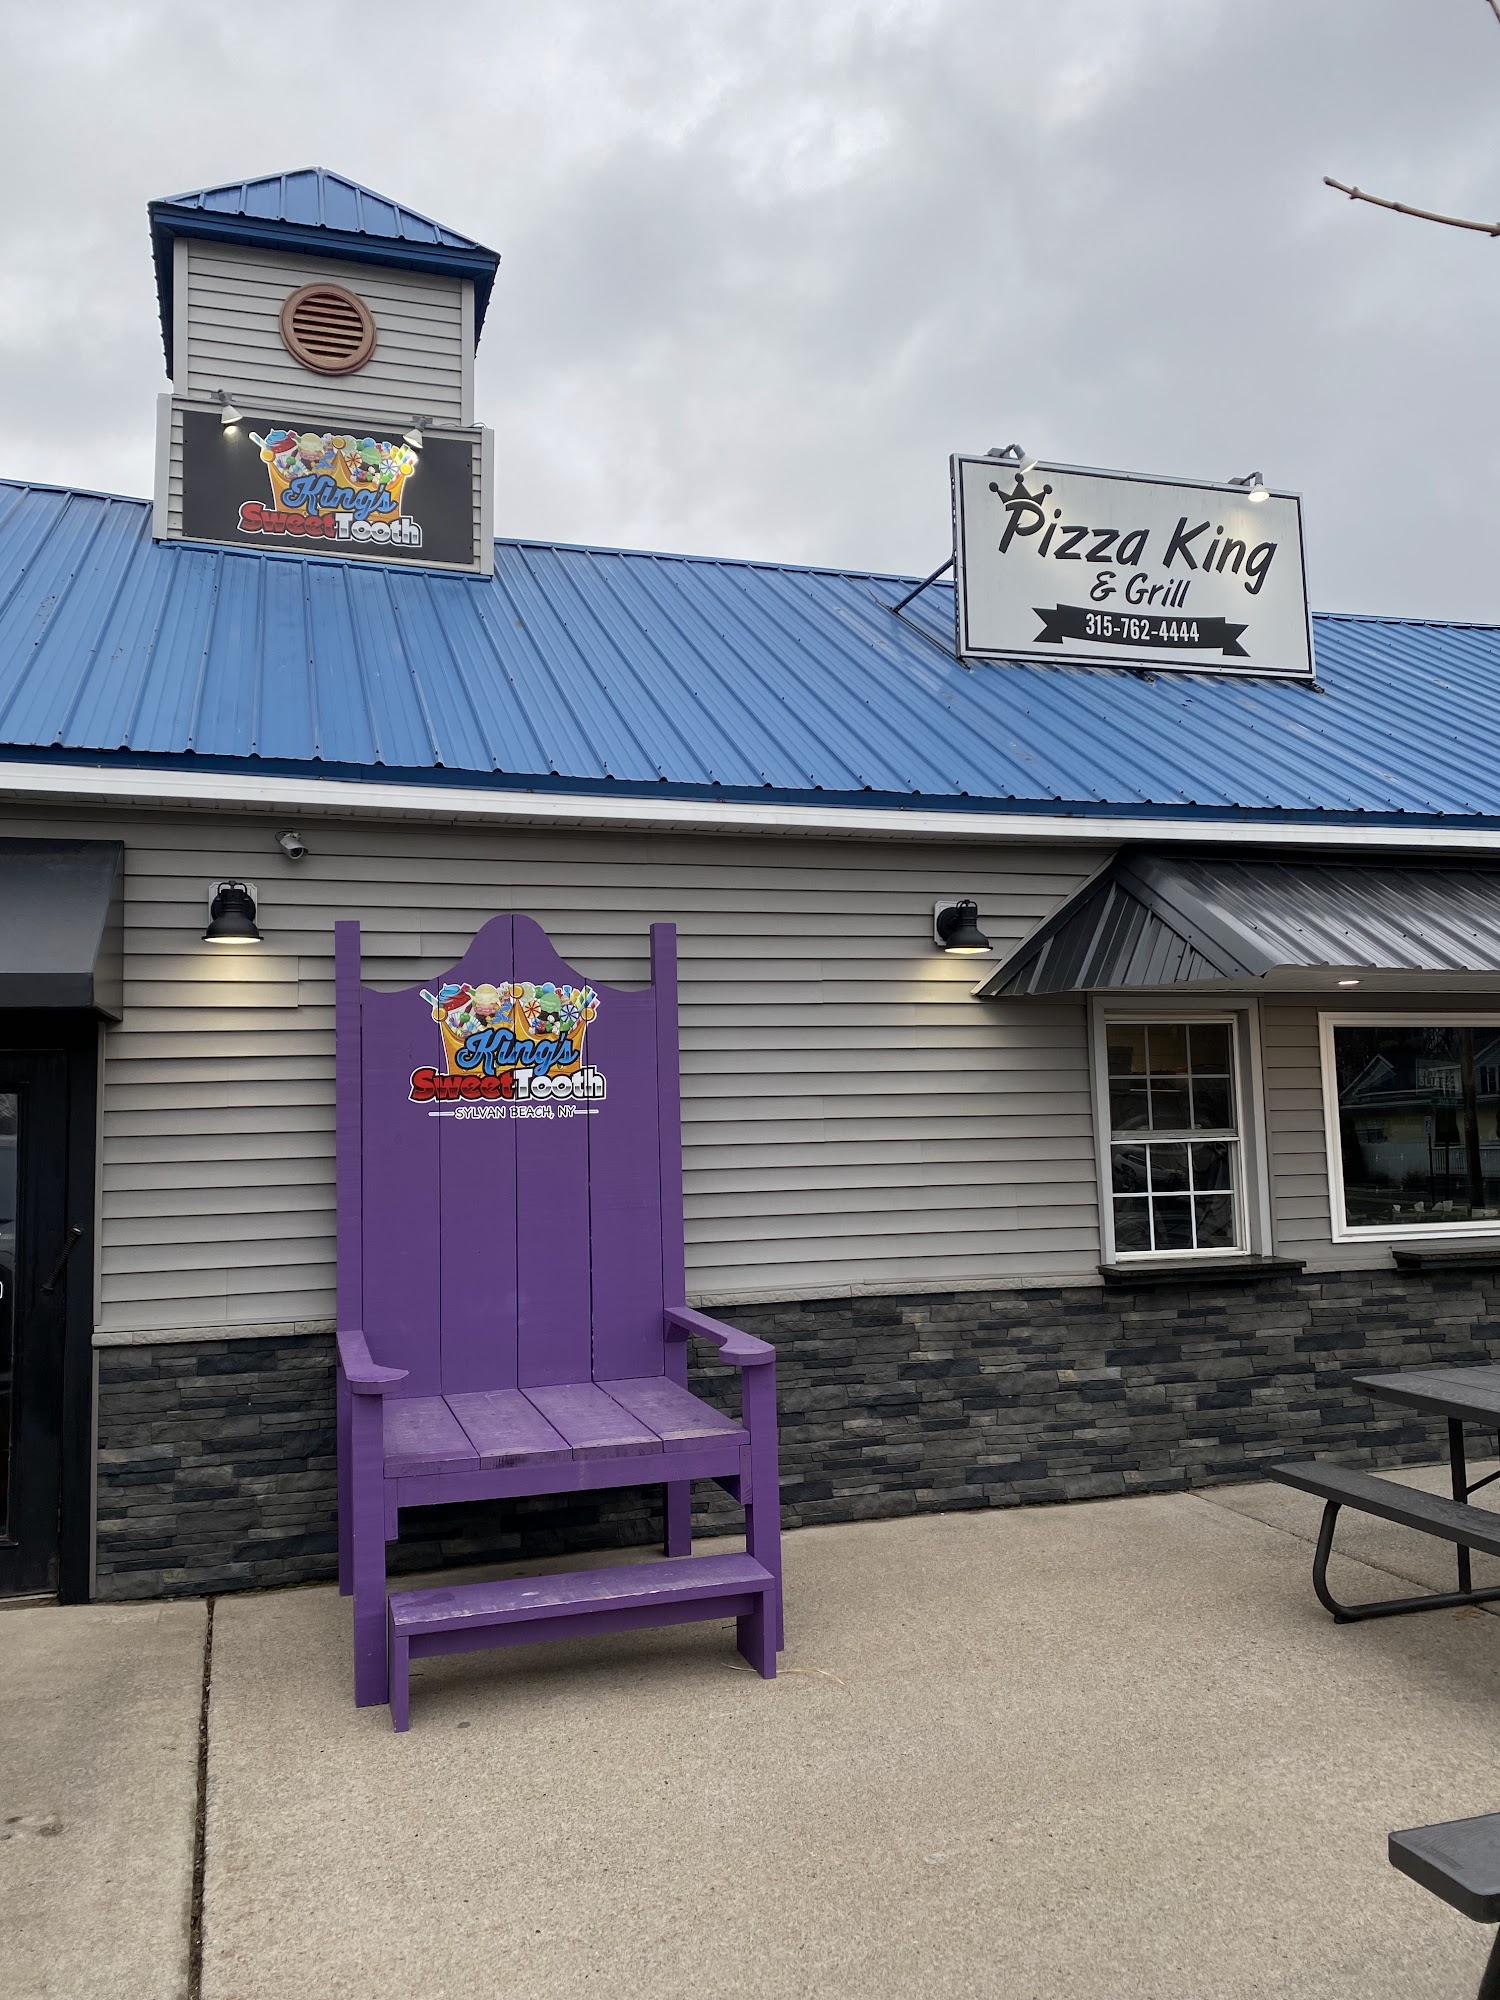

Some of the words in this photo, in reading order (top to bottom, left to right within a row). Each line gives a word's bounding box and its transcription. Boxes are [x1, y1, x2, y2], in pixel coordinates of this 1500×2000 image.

[283, 475, 397, 521] King's
[240, 503, 335, 538] Sweet
[335, 513, 421, 546] Tooth
[998, 500, 1150, 566] Pizza
[1162, 517, 1278, 595] King
[1090, 570, 1117, 602] &
[1125, 572, 1191, 608] Grill
[1085, 613, 1200, 642] 315-762-4444
[456, 1027, 580, 1076] King's
[411, 1067, 514, 1100] Sweet
[515, 1067, 606, 1100] Tooth
[455, 1106, 505, 1119] SYLVAN
[509, 1105, 554, 1119] BEACH,
[557, 1105, 576, 1117] NY
